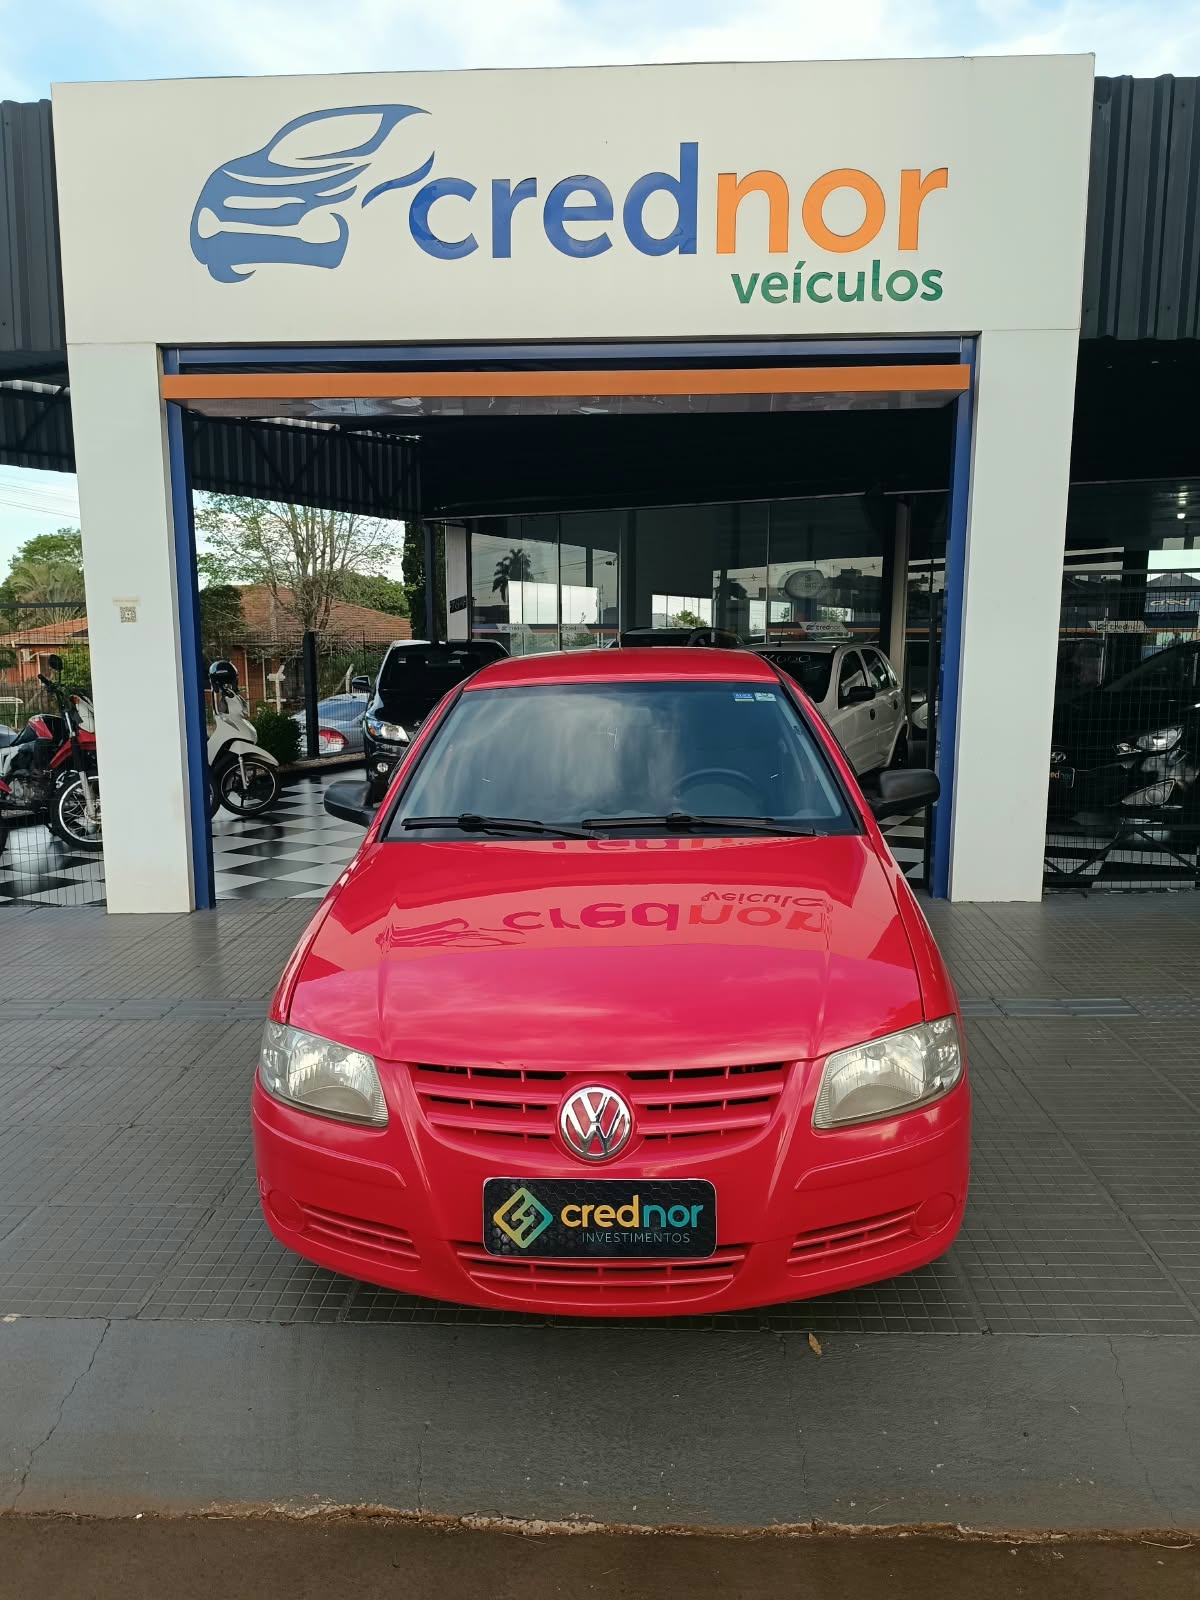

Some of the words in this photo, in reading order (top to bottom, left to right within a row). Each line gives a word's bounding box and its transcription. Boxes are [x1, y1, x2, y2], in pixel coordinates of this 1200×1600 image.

[408, 141, 949, 260] crednor
[731, 259, 944, 304] veículos
[560, 1194, 704, 1228] crednor
[581, 1232, 691, 1244] INVESTIMENTOS
